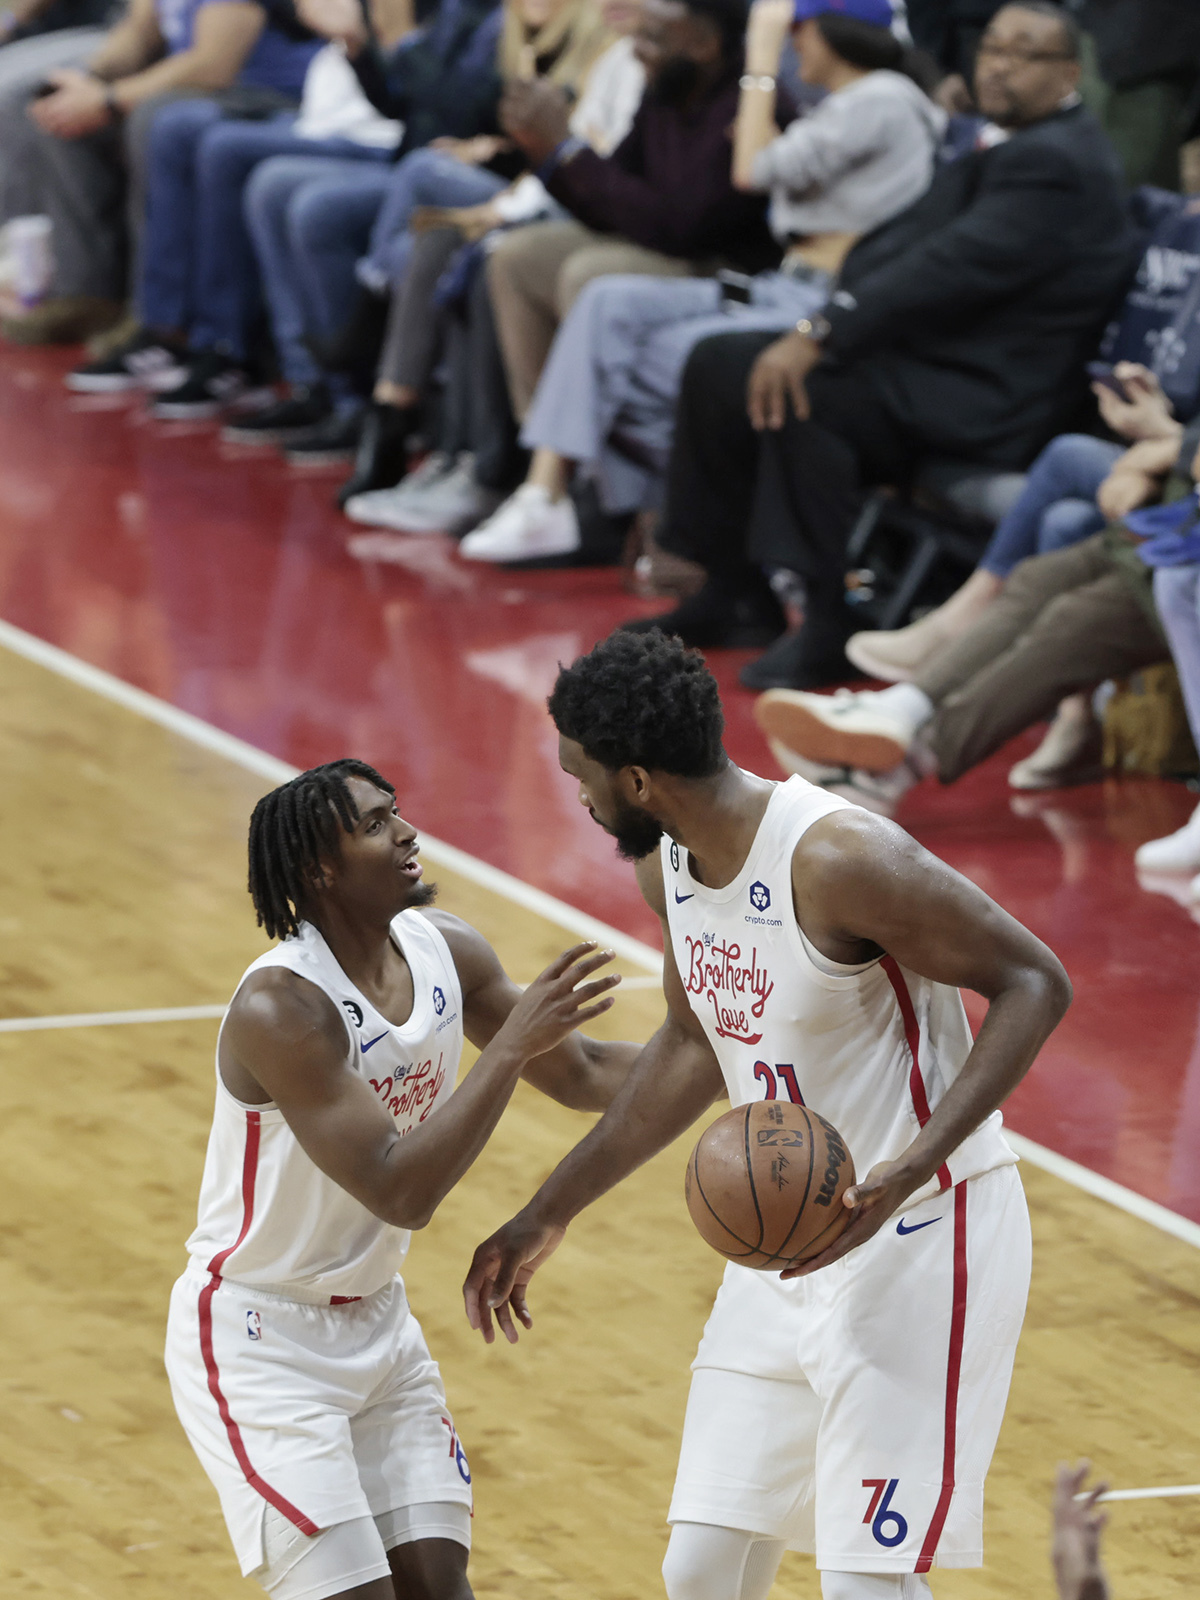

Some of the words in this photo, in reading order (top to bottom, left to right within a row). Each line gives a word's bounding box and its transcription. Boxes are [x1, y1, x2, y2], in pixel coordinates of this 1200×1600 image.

[745, 915, 783, 927] crypto.com
[684, 935, 774, 1018] Brotherly
[707, 989, 763, 1045] Love
[754, 1060, 806, 1107] 21
[861, 1478, 908, 1548] 76
